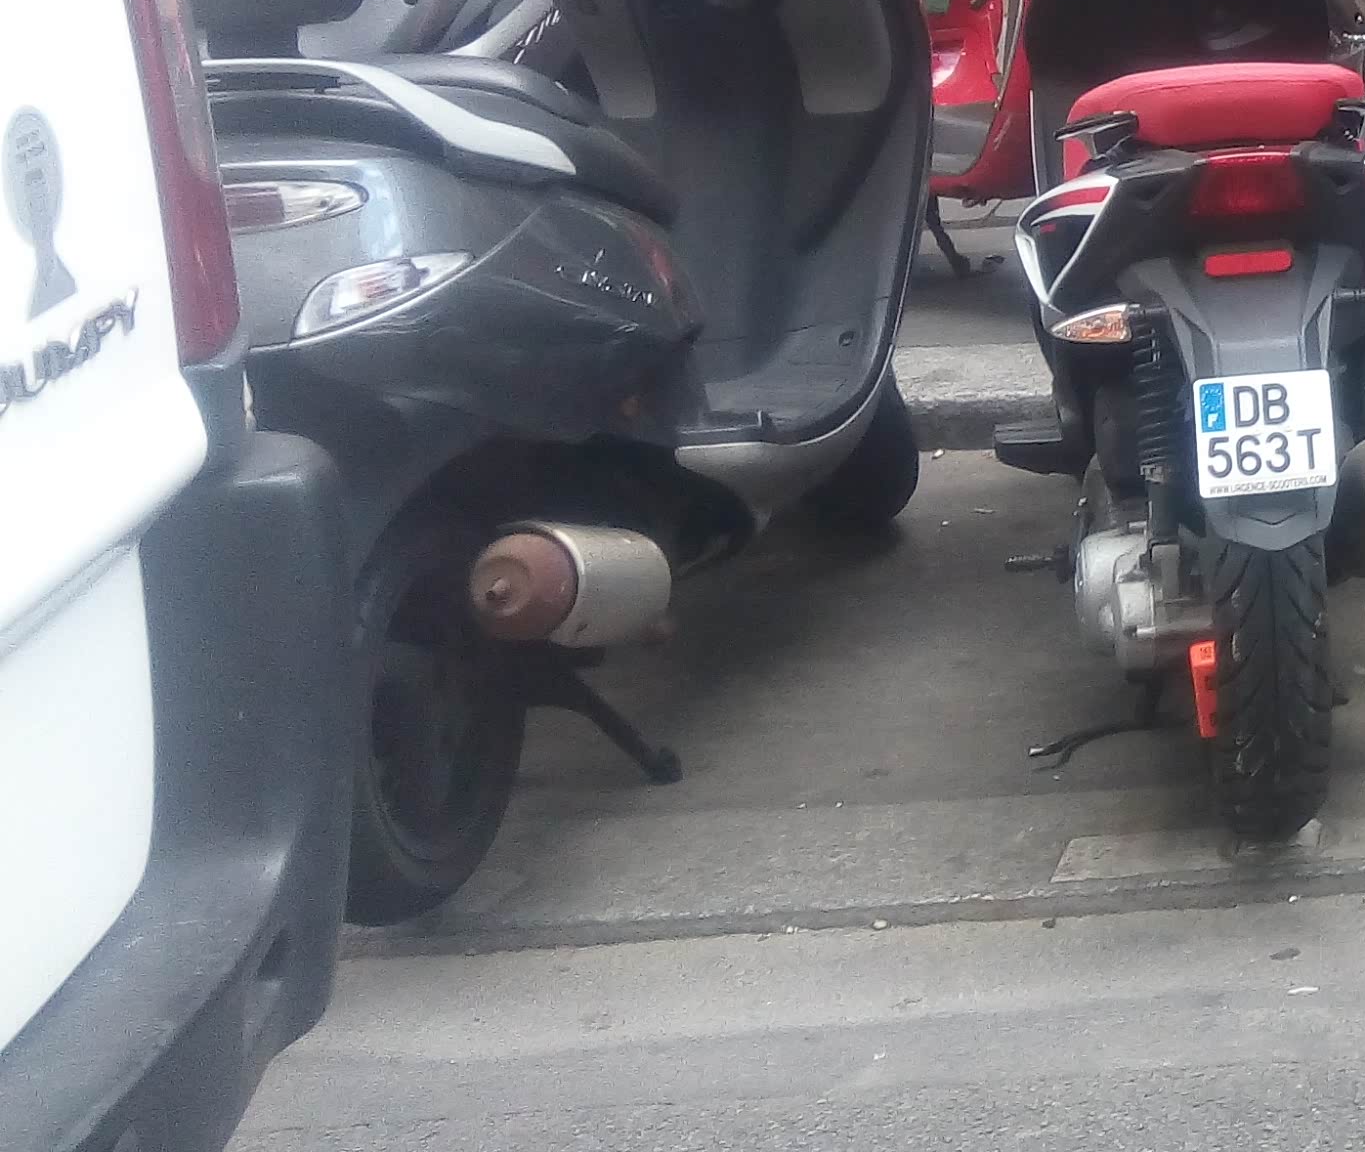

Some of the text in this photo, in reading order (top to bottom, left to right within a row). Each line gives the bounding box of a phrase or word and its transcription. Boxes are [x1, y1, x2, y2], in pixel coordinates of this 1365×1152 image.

[0, 285, 140, 417] UMPY
[1207, 412, 1219, 428] F
[1232, 383, 1291, 428] DB
